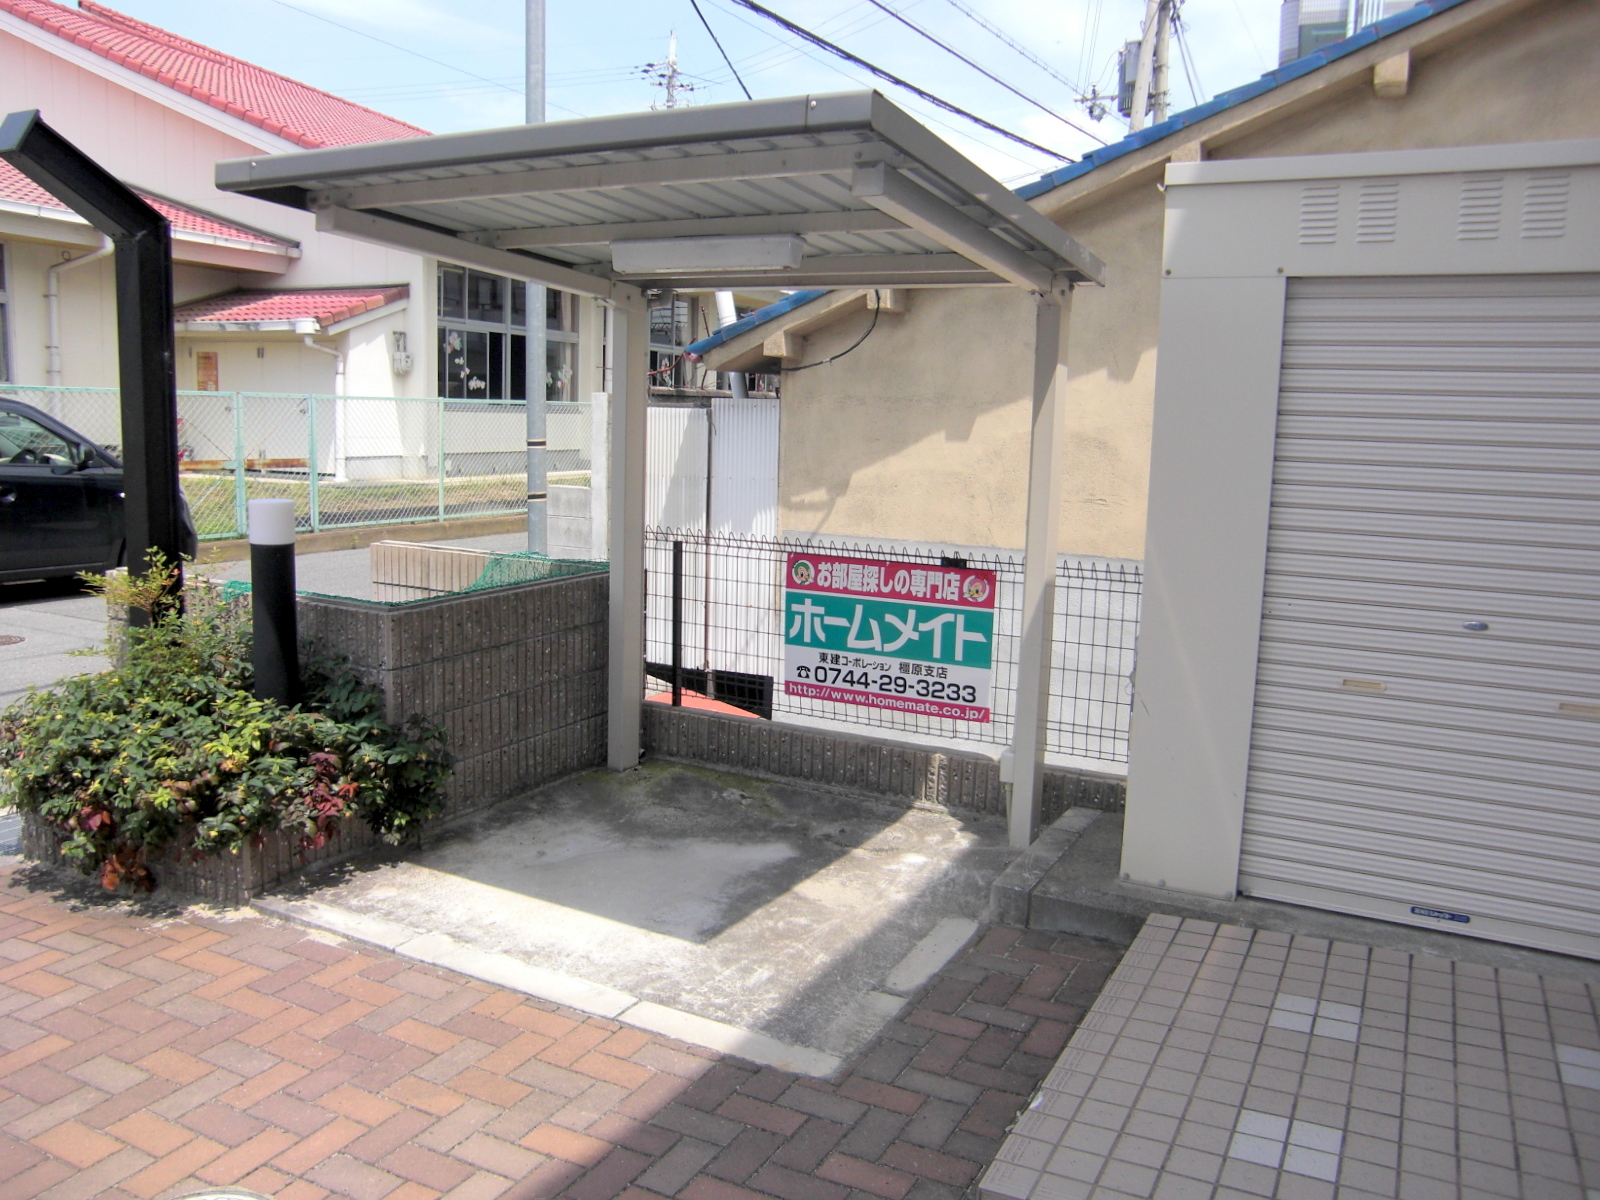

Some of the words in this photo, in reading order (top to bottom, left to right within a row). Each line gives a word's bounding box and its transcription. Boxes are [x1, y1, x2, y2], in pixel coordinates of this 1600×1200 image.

[817, 562, 960, 601] お部屋探しの専門店
[789, 598, 987, 661] ホームメイト
[814, 665, 977, 703] 0744-29-3233
[818, 652, 892, 672] 東建コーポレーション
[898, 661, 948, 679] 橿原支店
[789, 683, 985, 719] http://www.homemate.co.jp/
